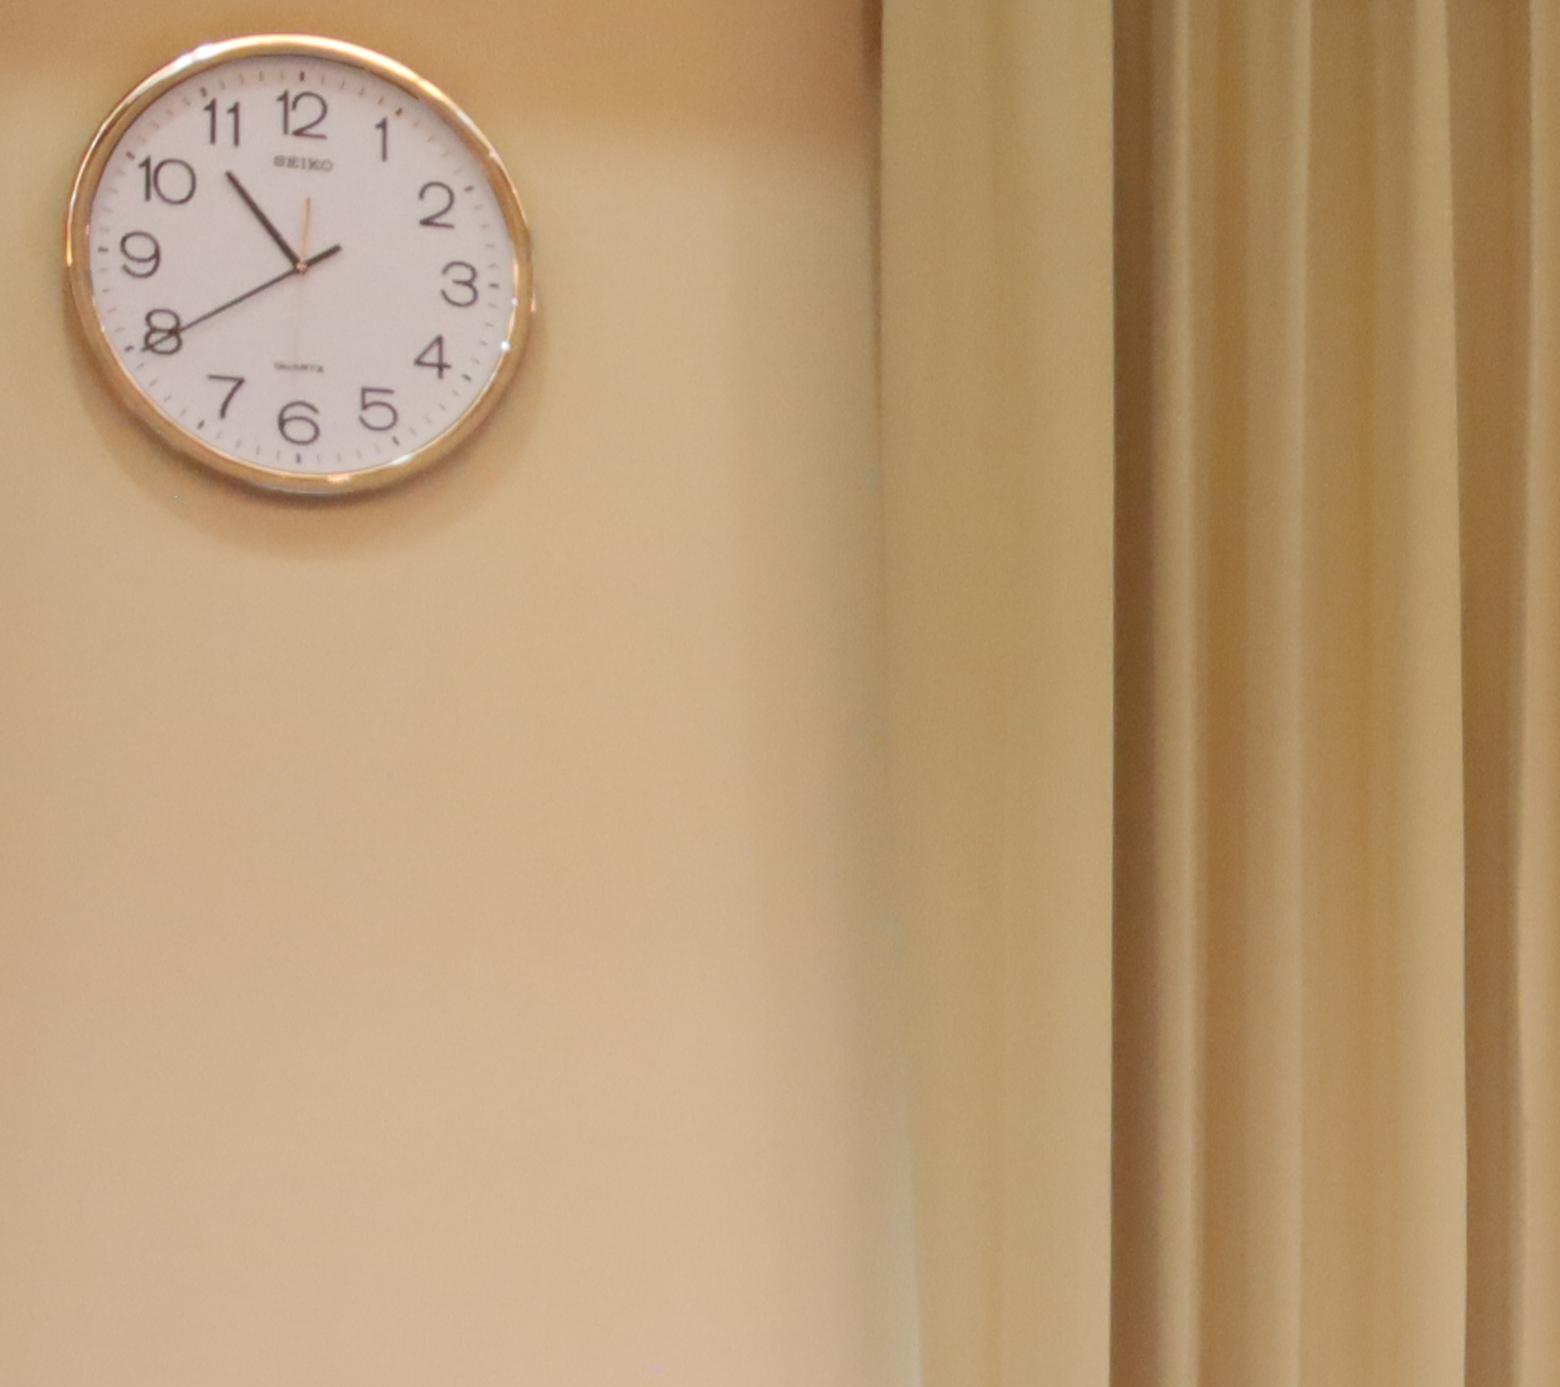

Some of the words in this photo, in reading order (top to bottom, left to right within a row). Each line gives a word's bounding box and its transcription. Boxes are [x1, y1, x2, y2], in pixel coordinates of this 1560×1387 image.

[204, 98, 240, 147] 11
[277, 90, 328, 140] 12
[374, 116, 388, 162] 1
[139, 156, 197, 205] 10
[273, 154, 334, 173] SEIKO
[418, 181, 455, 228] 2
[119, 231, 162, 278] 9
[440, 261, 479, 308] 3
[143, 308, 182, 356] 8
[413, 334, 452, 380] 4
[207, 374, 246, 420] 7
[358, 387, 399, 431] 5
[277, 401, 321, 446] 6
